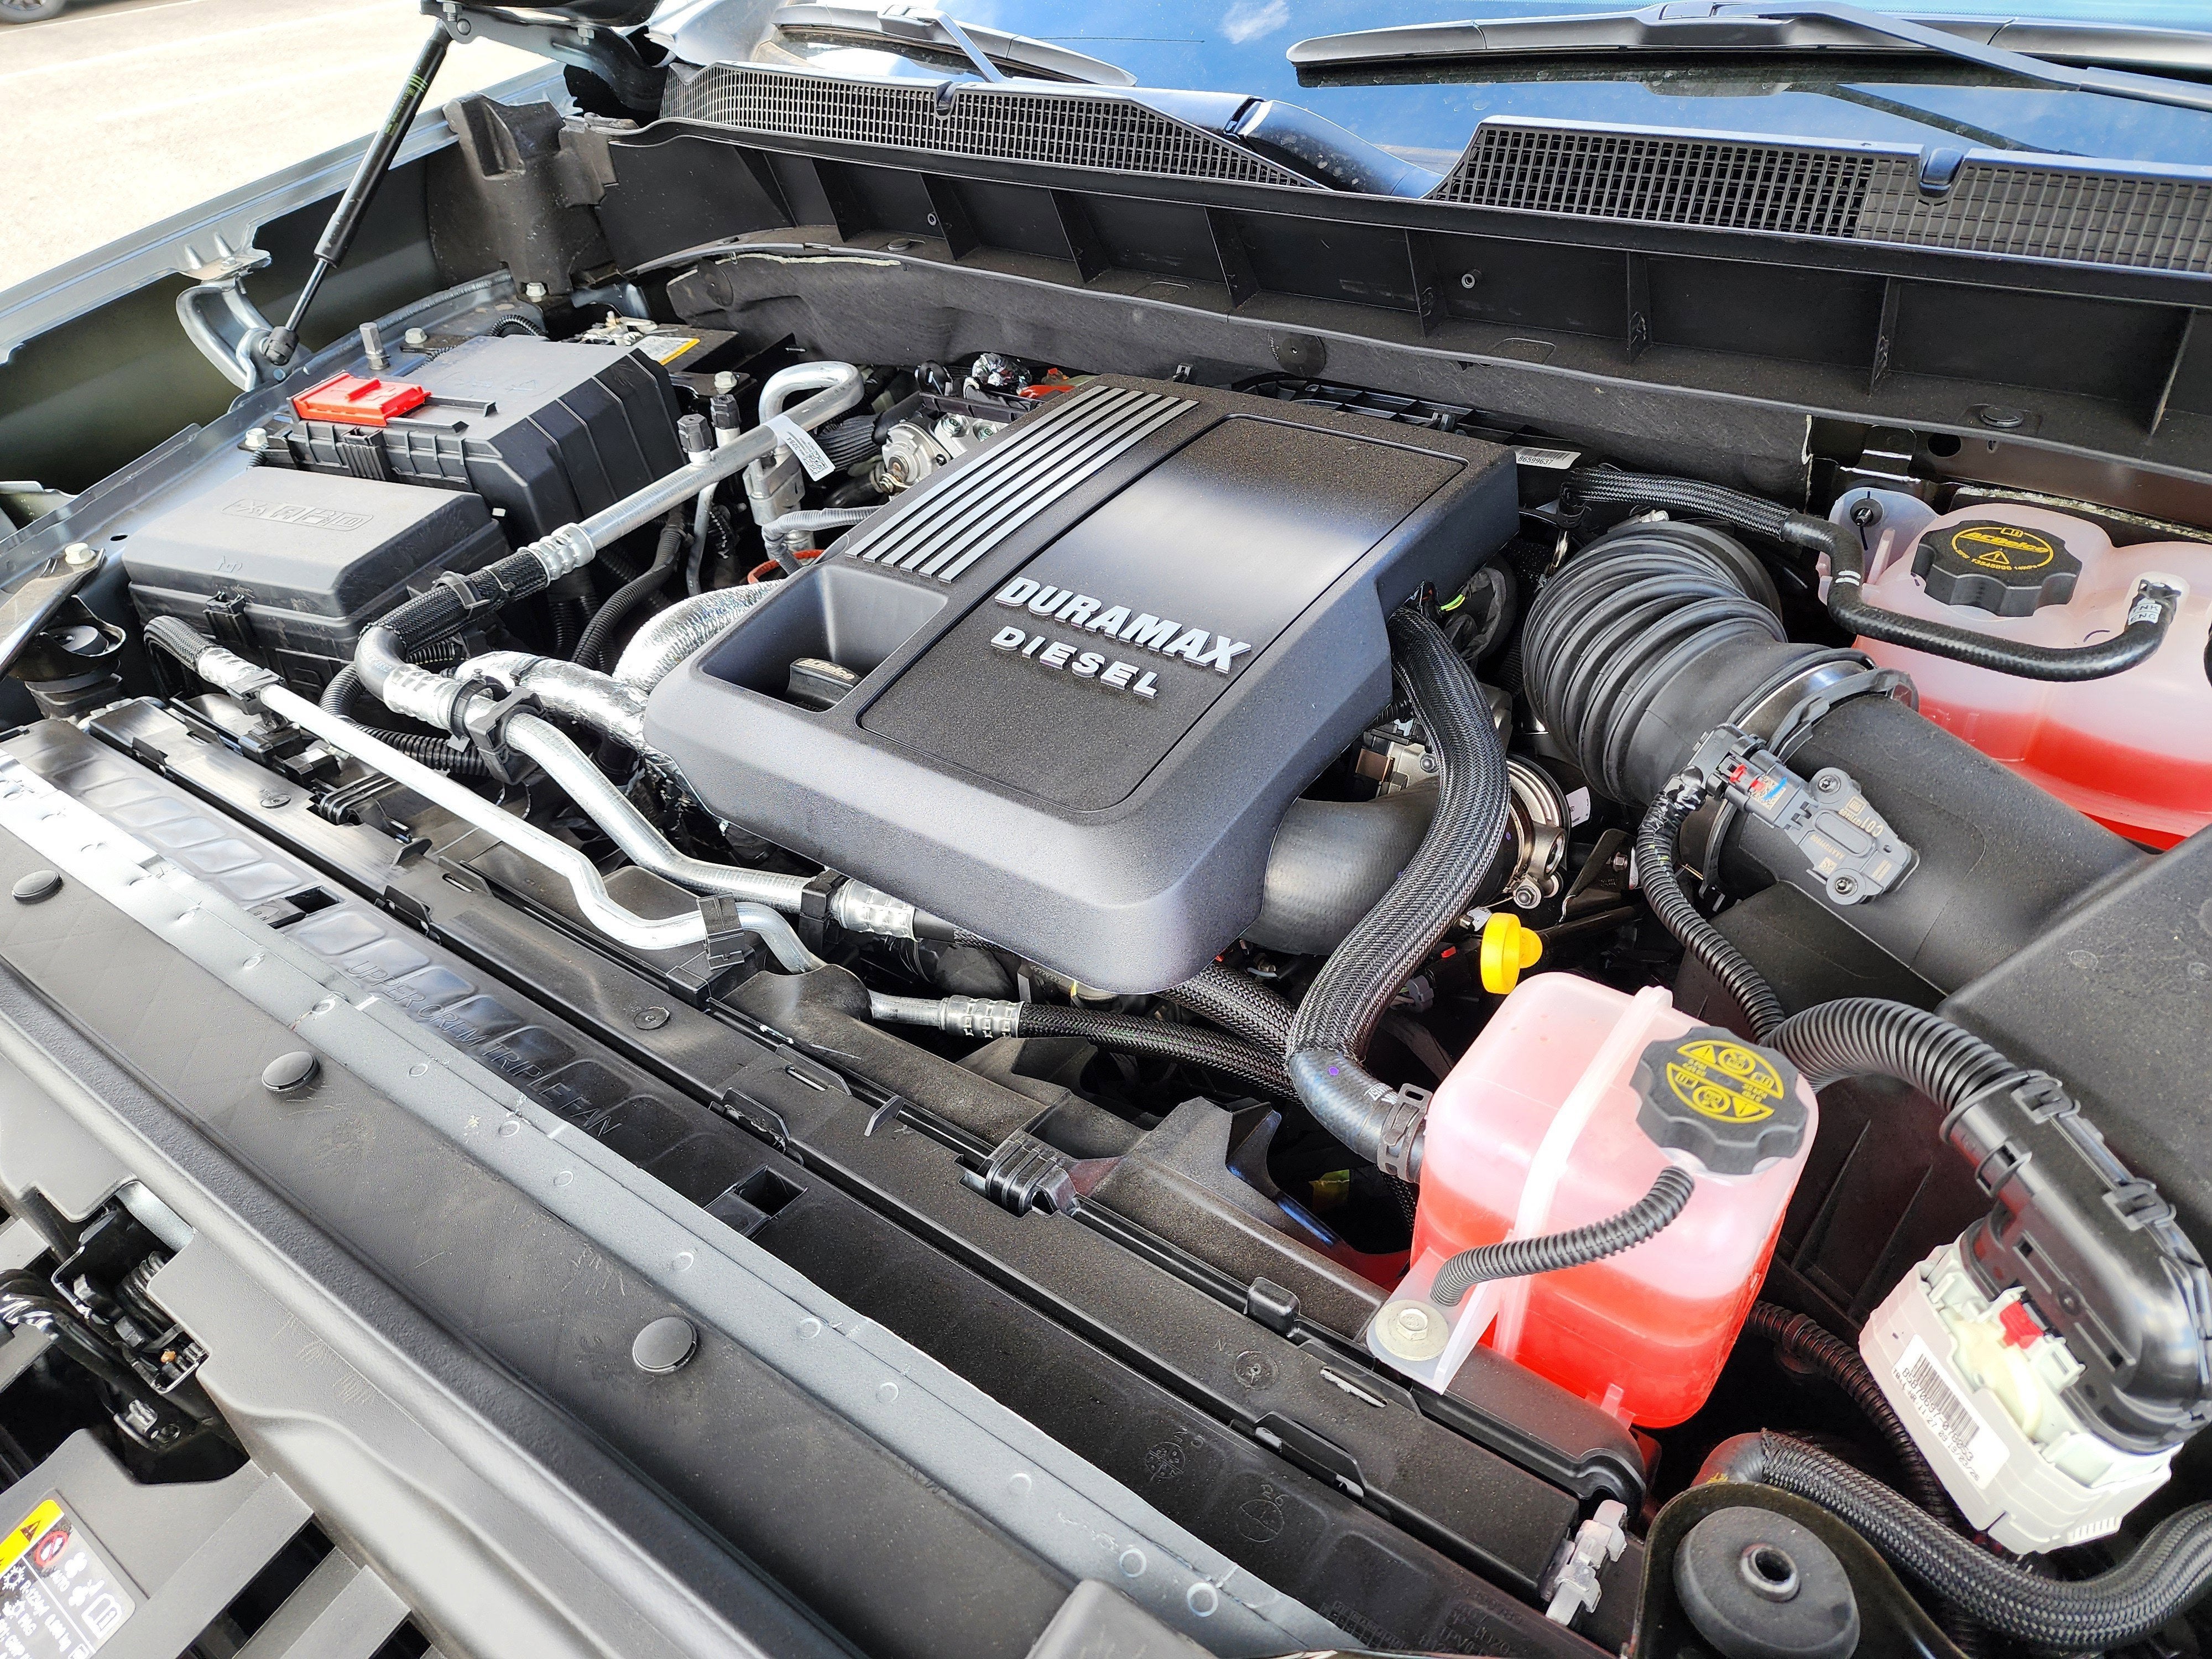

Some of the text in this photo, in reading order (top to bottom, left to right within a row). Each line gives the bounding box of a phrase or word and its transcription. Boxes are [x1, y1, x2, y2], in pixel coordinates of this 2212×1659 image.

[1518, 456, 1554, 466] 86599637
[1960, 531, 2049, 554] ACDelco
[994, 576, 1251, 674] DURAMAX
[795, 658, 855, 682] ACDelco
[990, 625, 1159, 699] DIESEL
[347, 960, 623, 1138] UPPER CRFM TRIPLE FAN
